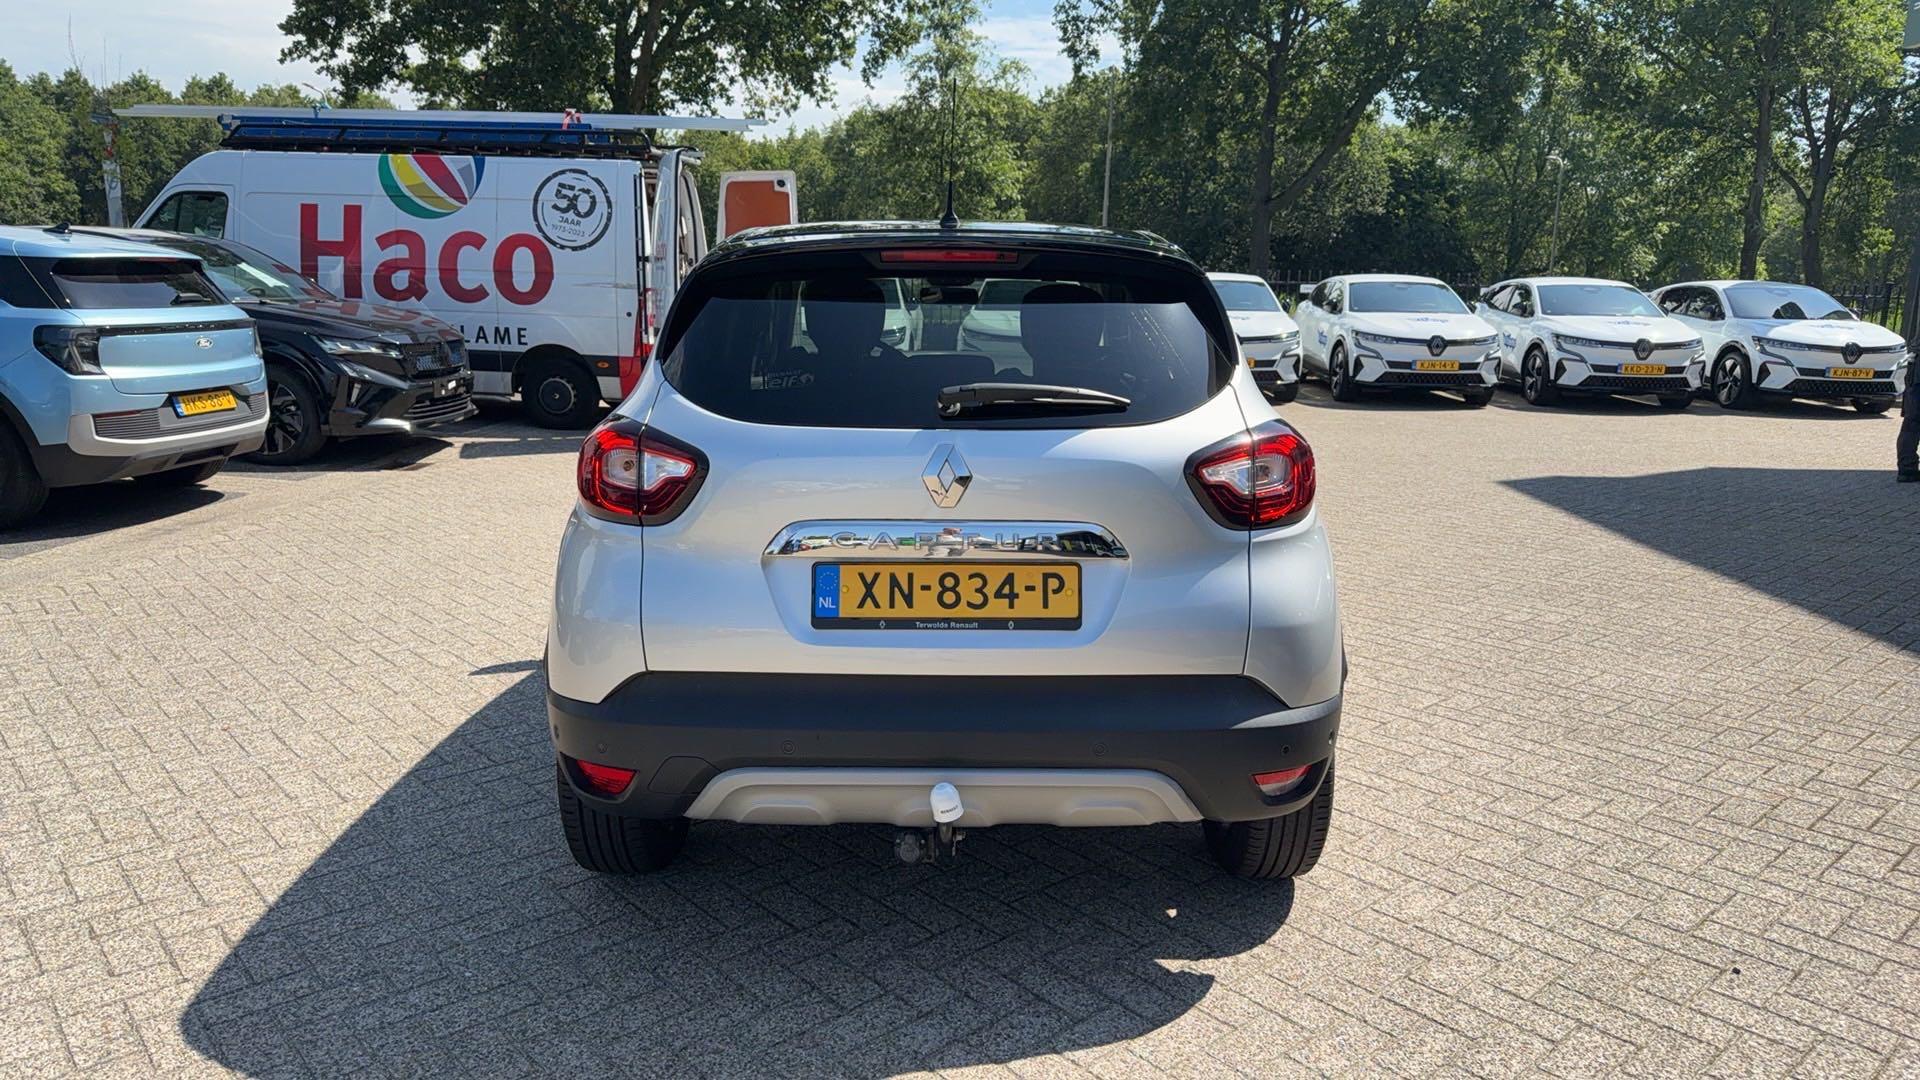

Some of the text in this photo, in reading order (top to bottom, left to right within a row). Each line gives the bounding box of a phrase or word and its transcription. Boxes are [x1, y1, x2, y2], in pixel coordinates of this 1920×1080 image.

[551, 182, 597, 219] 50
[551, 223, 586, 238] 1973-2023
[558, 216, 582, 227] JAAR
[300, 203, 554, 305] Haco
[460, 324, 528, 345] LAME
[832, 531, 1058, 551] CAPTUR
[856, 572, 1066, 610] XN-834-P
[818, 596, 836, 609] NL
[915, 621, 979, 629] Terwolde Renault
